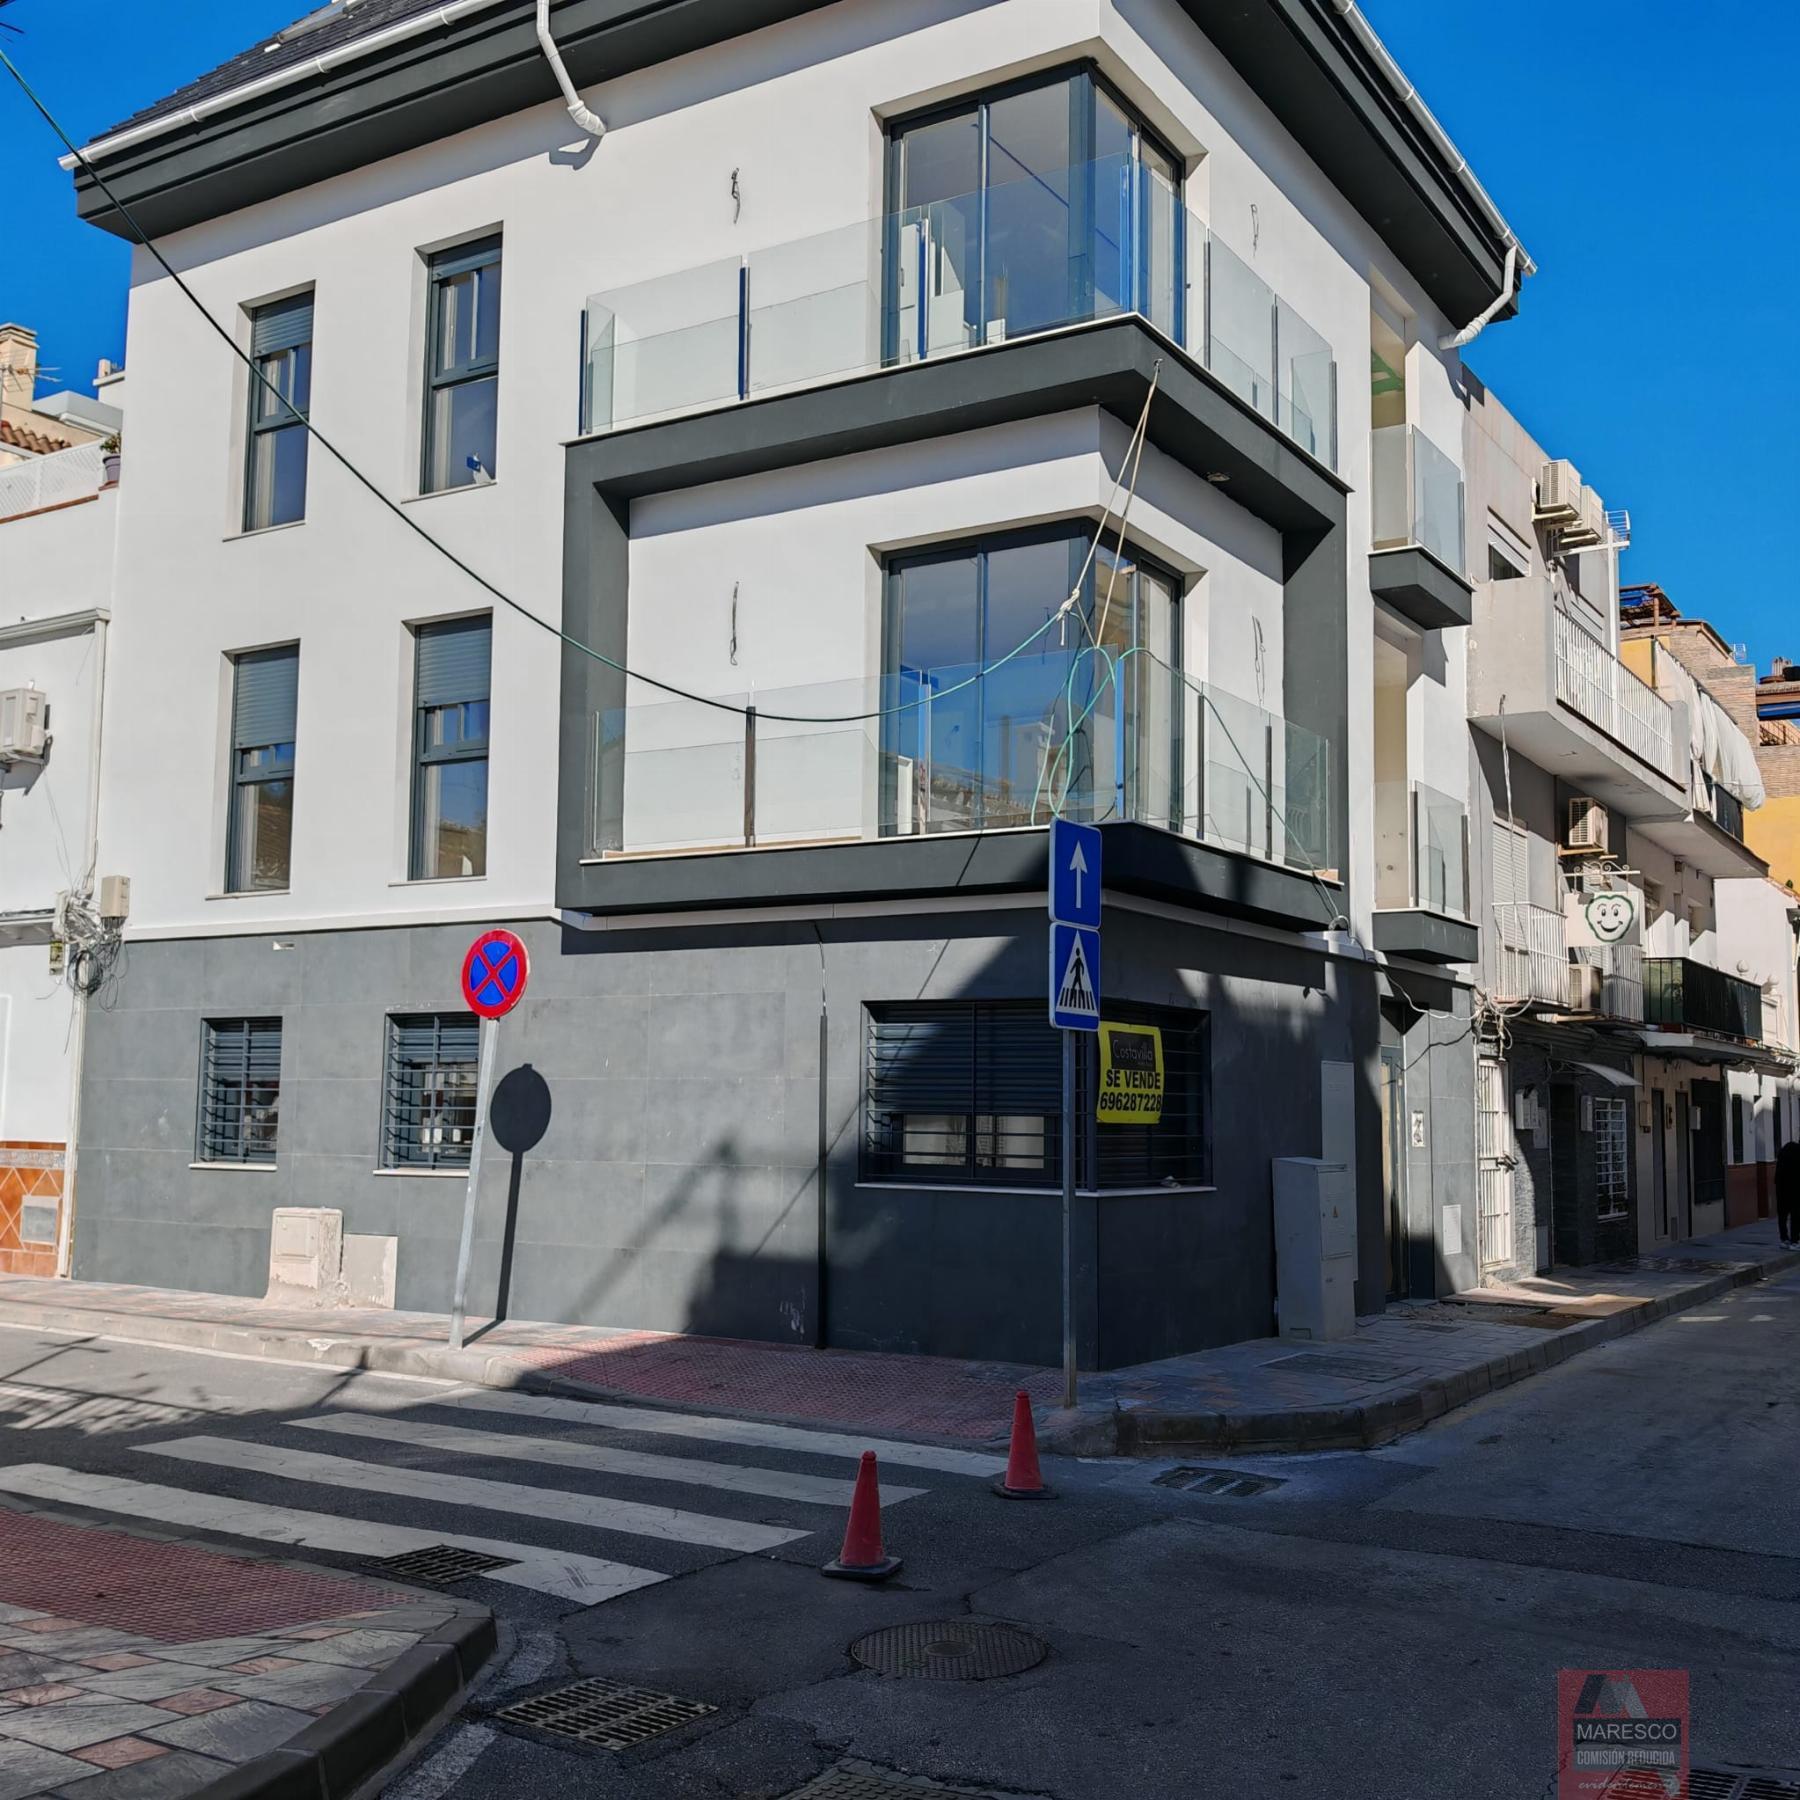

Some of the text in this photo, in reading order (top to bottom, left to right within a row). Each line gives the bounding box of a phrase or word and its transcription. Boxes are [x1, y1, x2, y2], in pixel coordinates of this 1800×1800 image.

[1106, 1069, 1161, 1090] SE VENDE
[1100, 1091, 1162, 1112] 696287228
